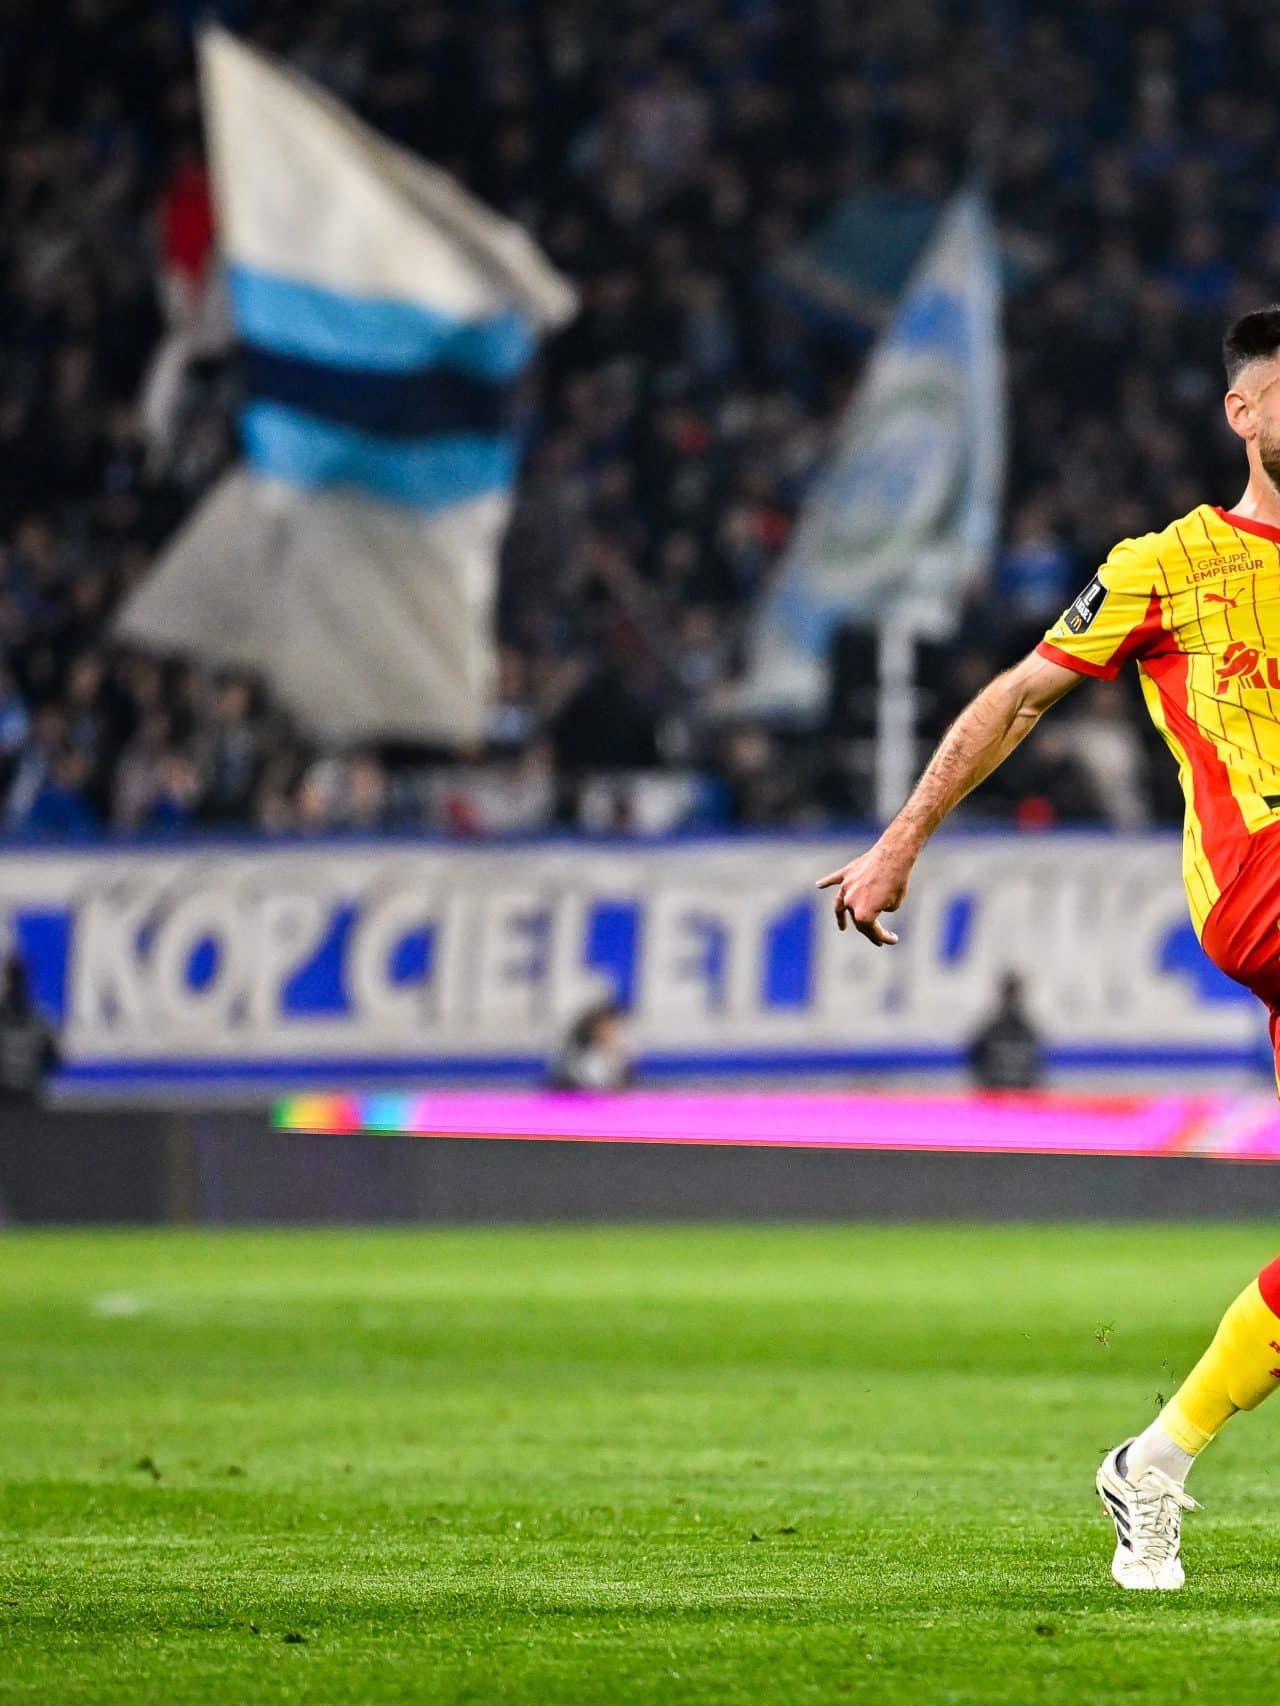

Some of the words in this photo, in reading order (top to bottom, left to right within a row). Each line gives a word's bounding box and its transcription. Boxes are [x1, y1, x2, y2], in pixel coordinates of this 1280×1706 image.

[1185, 559, 1264, 585] LEMPEREUR
[1197, 552, 1248, 571] GROUPE
[72, 880, 335, 1032] KOP
[343, 882, 620, 1032] CIEL
[637, 882, 776, 1032] ET
